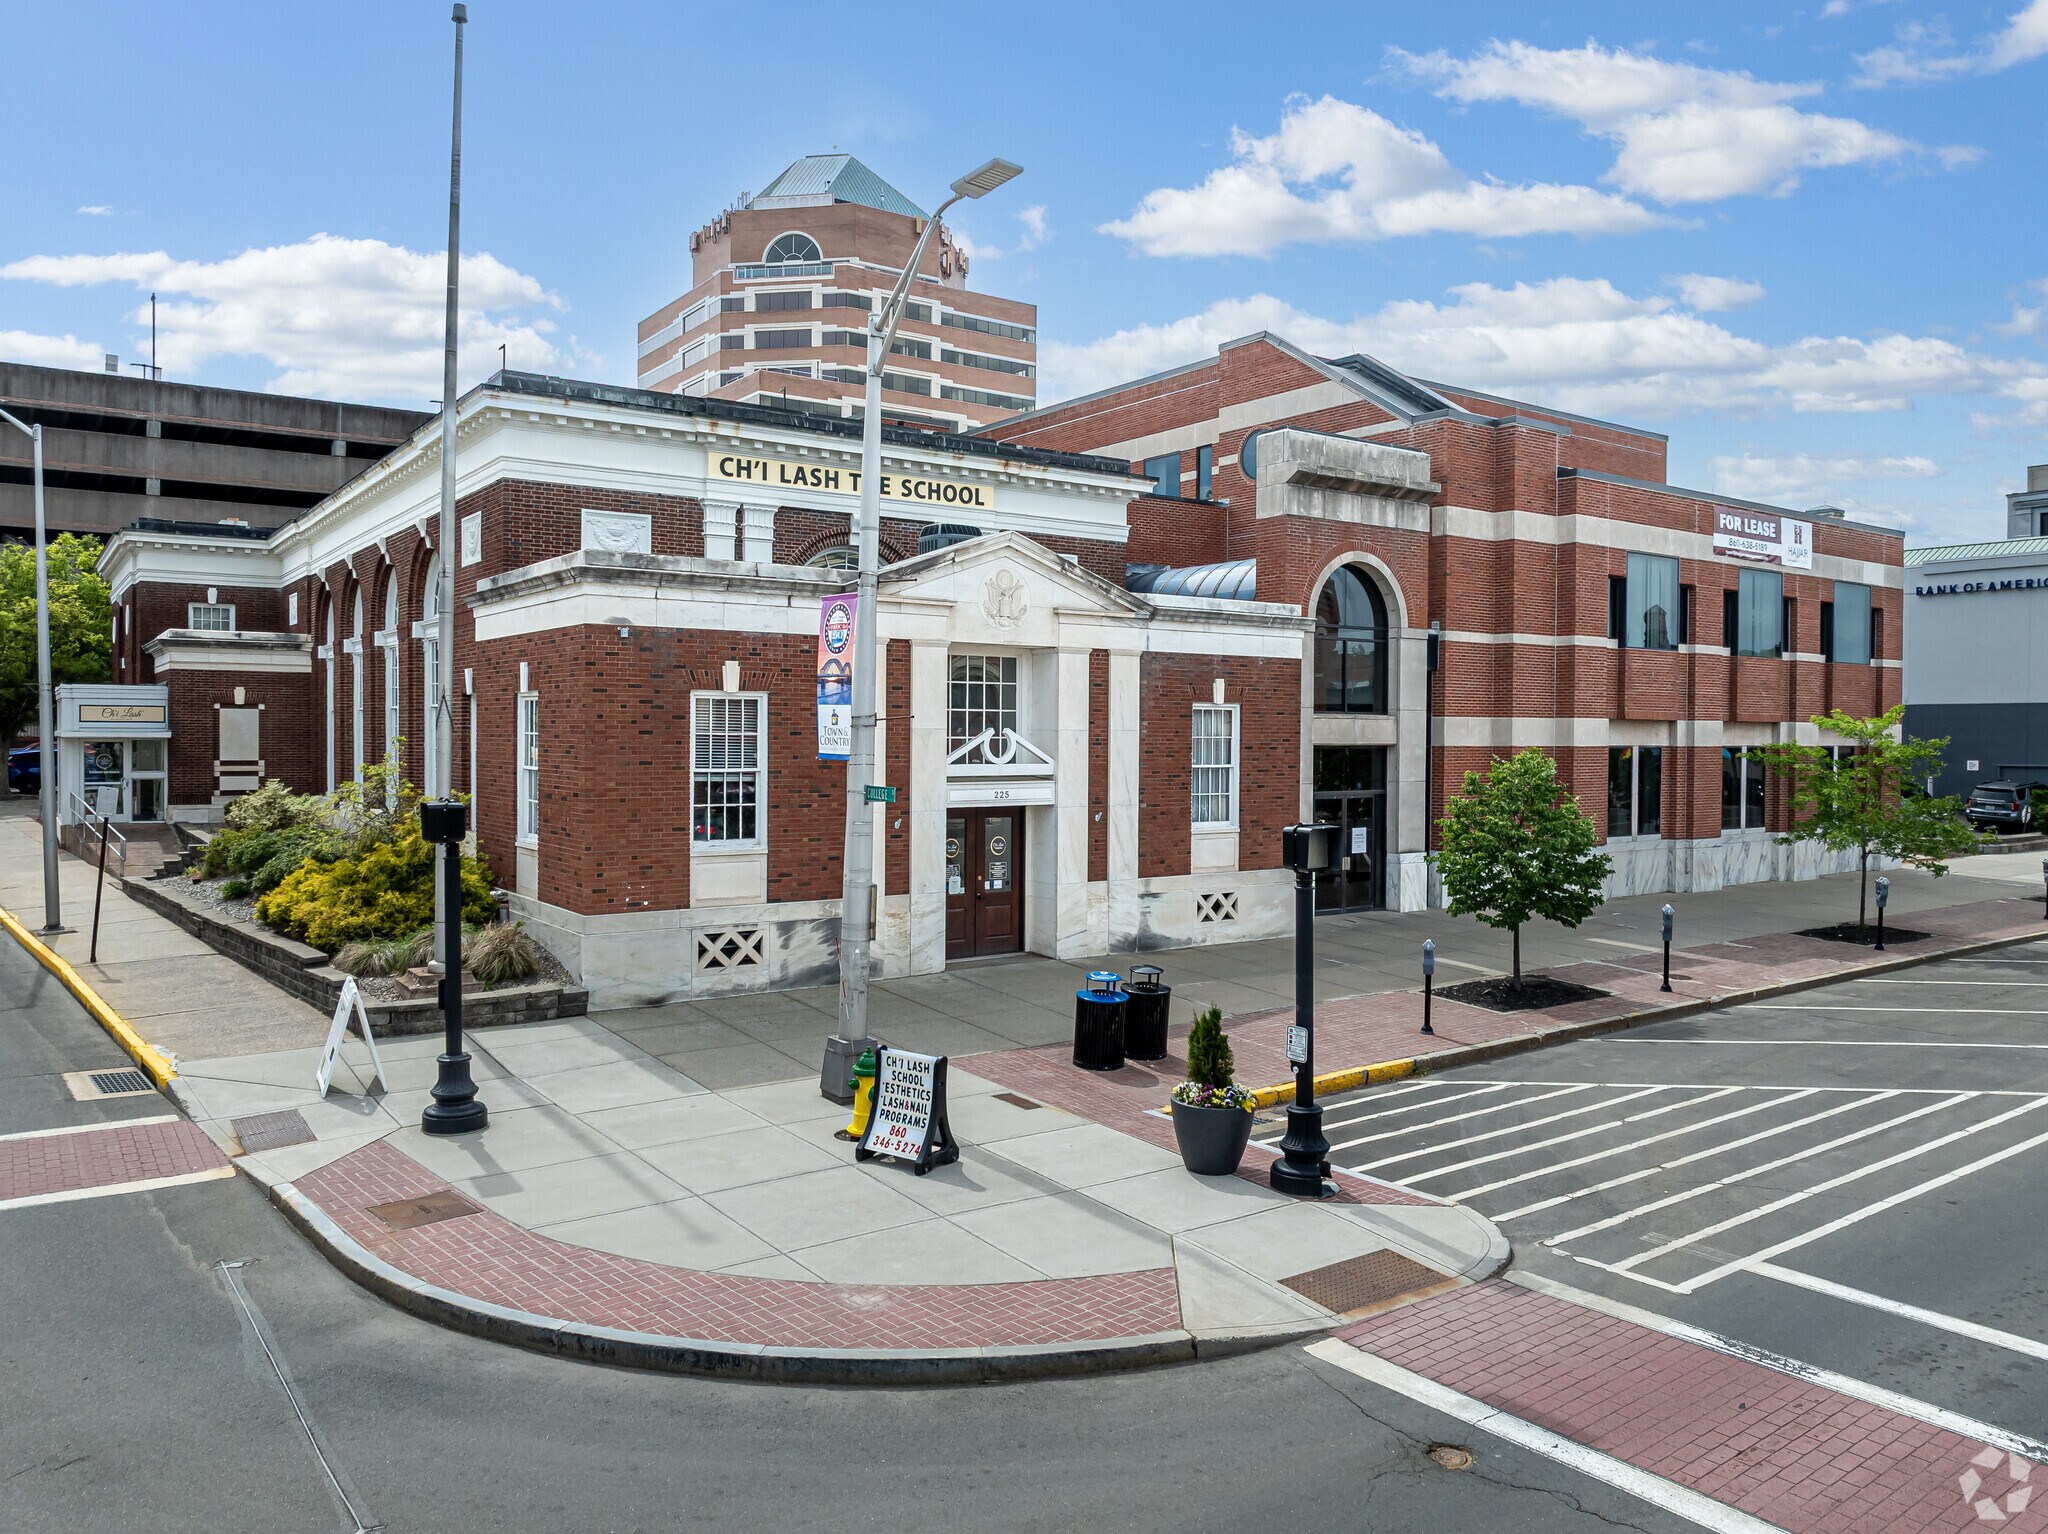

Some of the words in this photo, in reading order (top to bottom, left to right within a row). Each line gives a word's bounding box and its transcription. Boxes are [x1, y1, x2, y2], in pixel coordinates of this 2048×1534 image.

[719, 457, 768, 481] CH'I
[779, 463, 839, 490] LASH
[848, 473, 891, 495] TE
[901, 479, 985, 506] SCHOOL
[1719, 513, 1742, 532] FOR
[1744, 518, 1776, 538] LEASE
[1788, 546, 1808, 558] HAJJAR
[1916, 584, 1959, 596] BANK
[1963, 582, 1984, 593] OF
[820, 735, 850, 746] COUNTRY
[867, 787, 888, 800] COLLEGE
[994, 790, 1010, 799] 225
[907, 1059, 930, 1074] LASH
[891, 1070, 924, 1087] SCHOOL
[879, 1108, 927, 1129] PROGRAMS
[889, 1125, 907, 1139] 860
[872, 1135, 921, 1156] 346-5274
